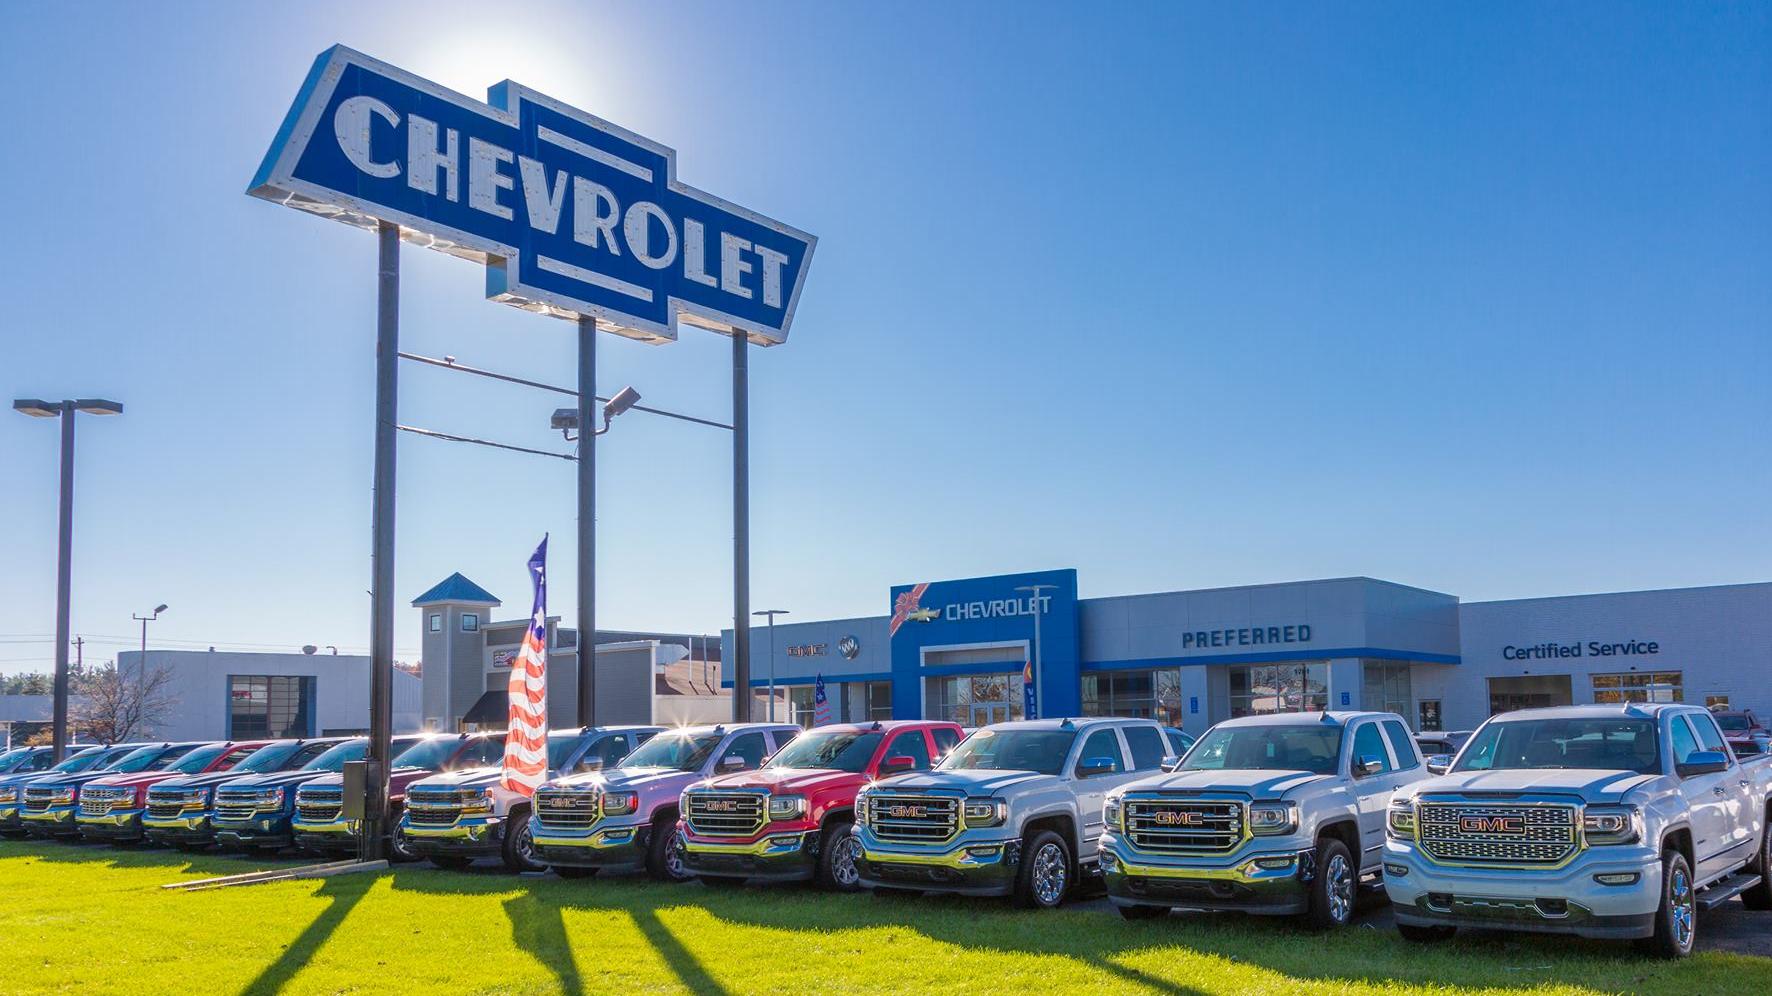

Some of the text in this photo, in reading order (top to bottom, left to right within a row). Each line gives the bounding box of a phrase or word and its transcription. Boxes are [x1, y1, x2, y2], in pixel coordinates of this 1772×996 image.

[334, 95, 789, 309] CHEVROLET
[945, 596, 1052, 621] CHEVROLET
[1182, 624, 1312, 649] PREFERRED
[786, 643, 827, 657] GMC
[1503, 639, 1660, 661] Certified Service
[706, 800, 737, 811] GMC
[889, 805, 927, 818] GMC
[1155, 811, 1203, 825] GMC
[1460, 816, 1523, 832] GMC
